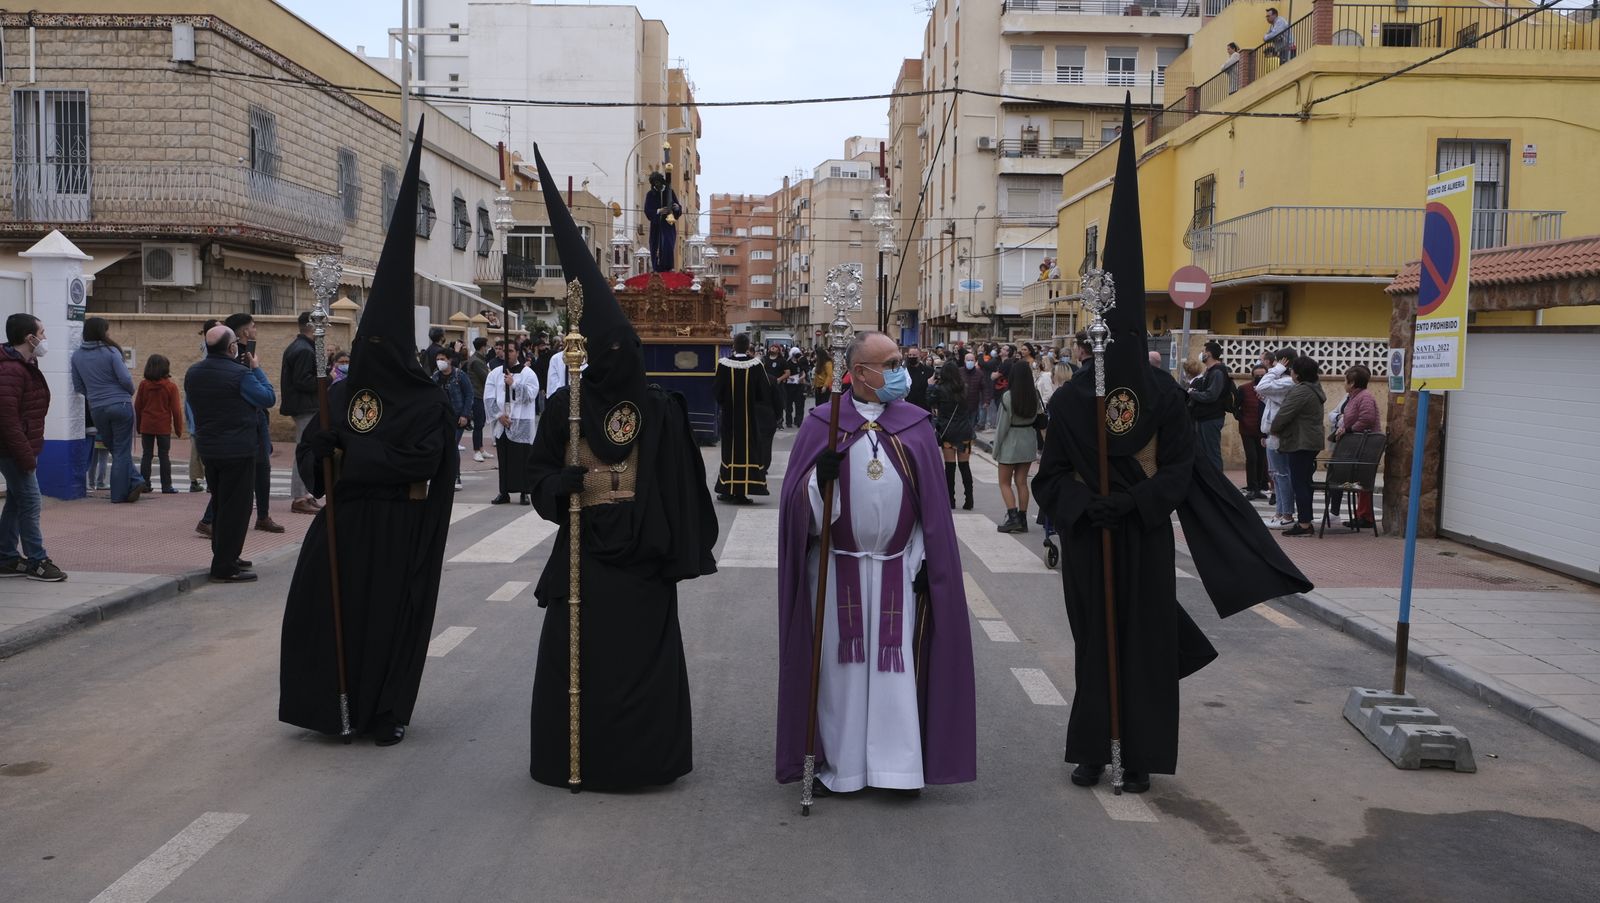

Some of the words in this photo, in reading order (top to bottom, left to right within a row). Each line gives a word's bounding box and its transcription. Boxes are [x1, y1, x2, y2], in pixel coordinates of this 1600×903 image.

[1442, 184, 1447, 192] DE
[1430, 320, 1458, 330] PROHIBIDO
[1416, 344, 1435, 352] SANTA
[1437, 343, 1450, 351] 2022
